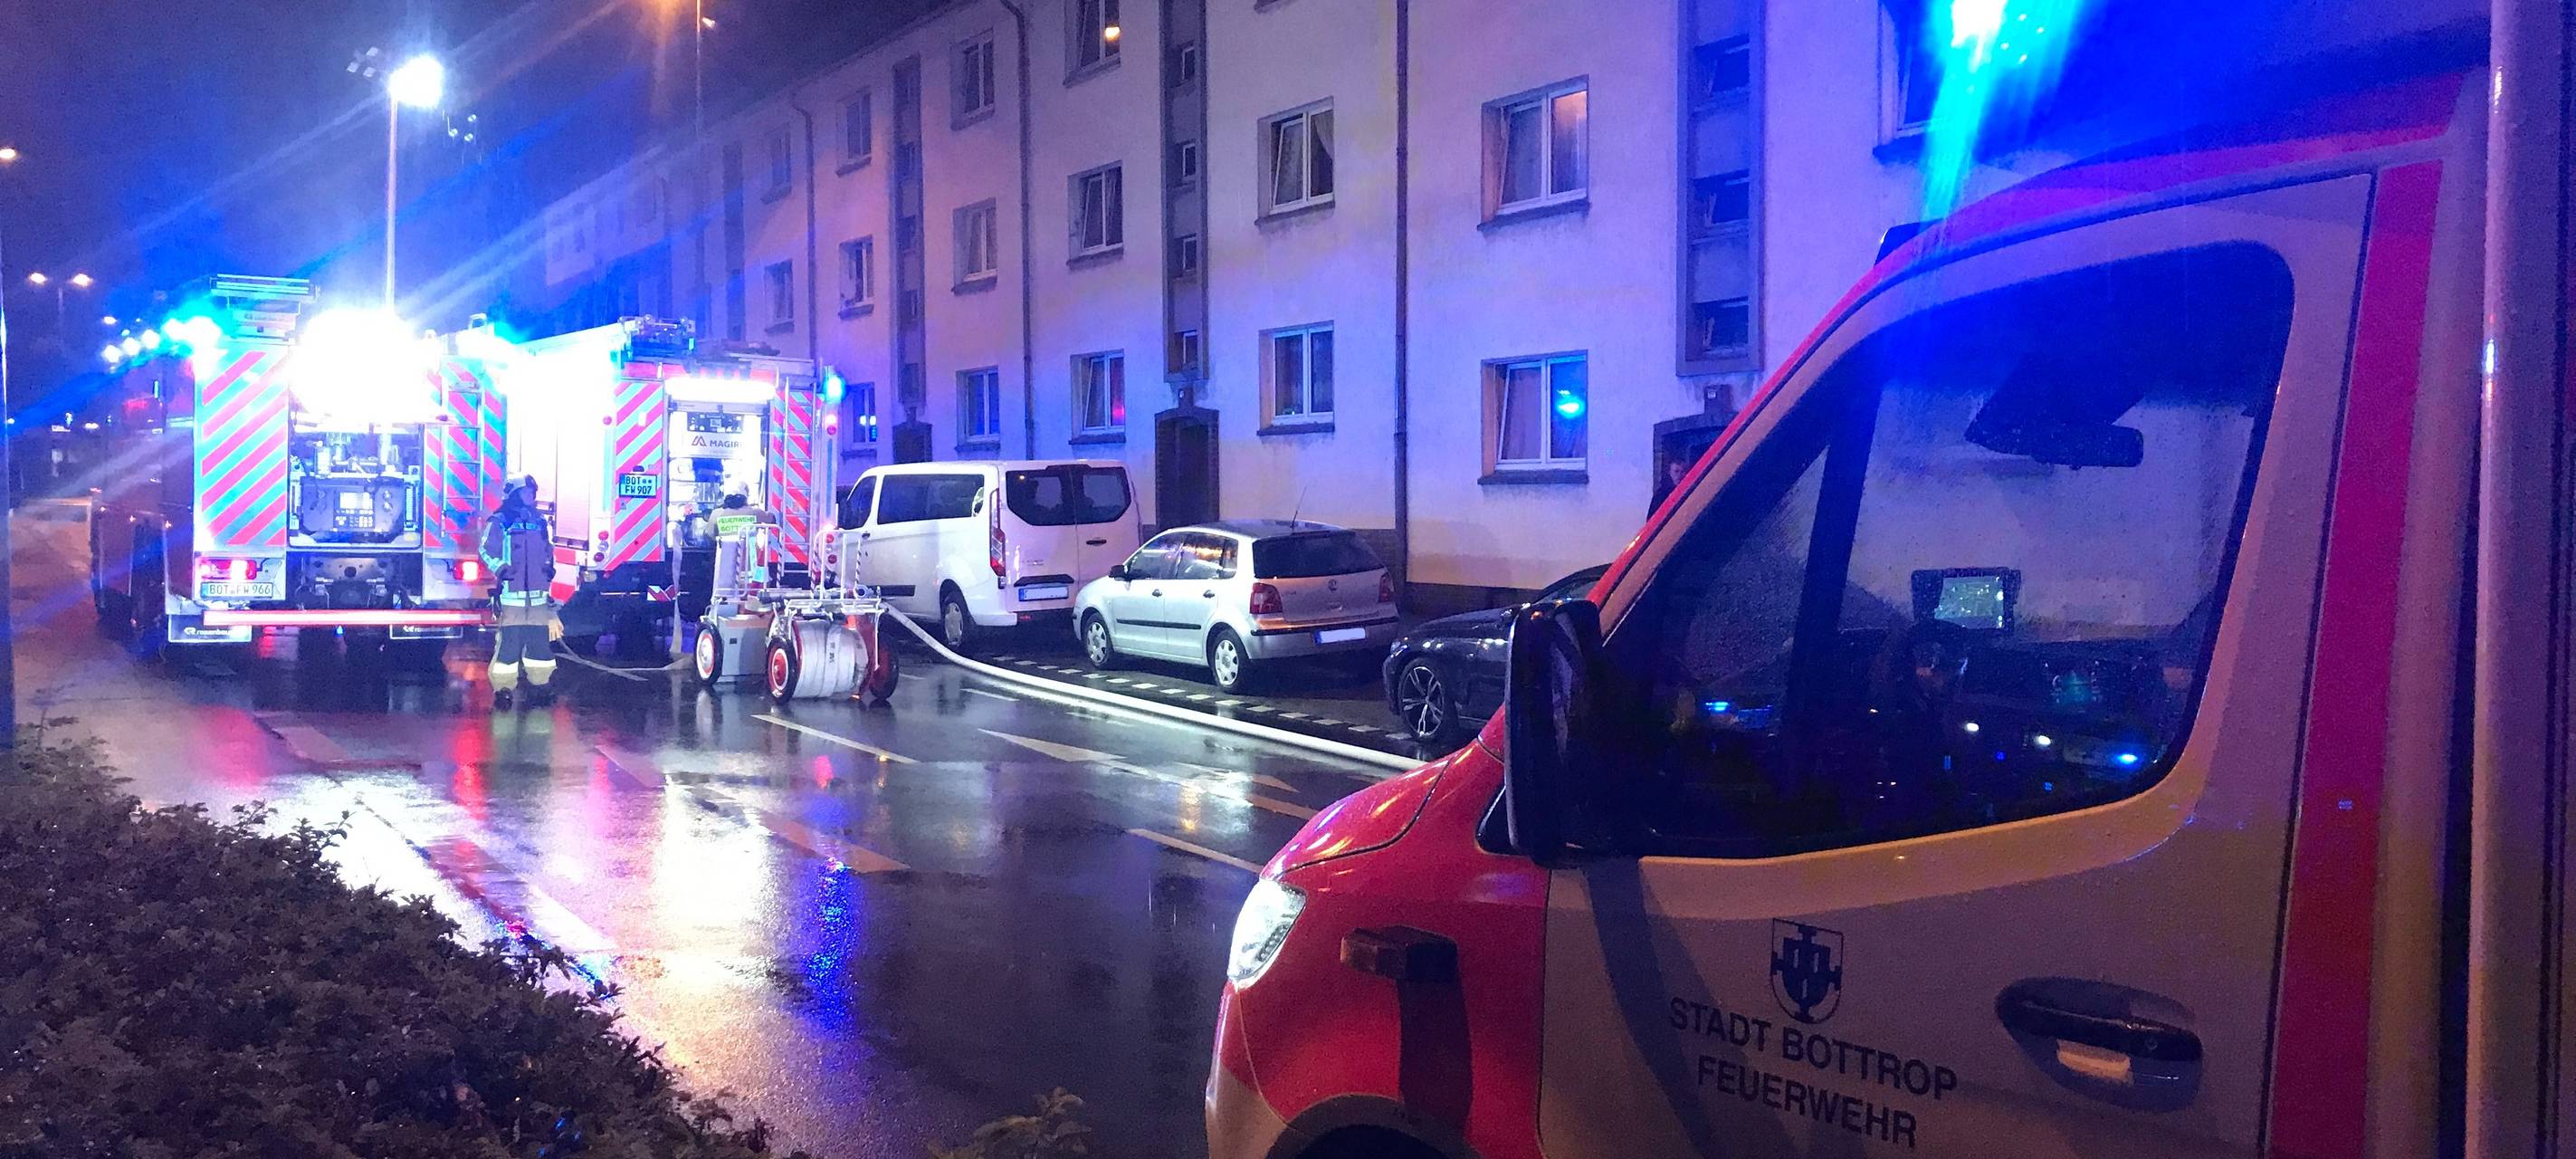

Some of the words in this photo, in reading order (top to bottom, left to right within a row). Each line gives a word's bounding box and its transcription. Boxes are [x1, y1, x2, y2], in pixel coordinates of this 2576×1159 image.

[710, 439, 742, 448] MAGIR
[625, 476, 641, 485] BOT
[625, 485, 636, 494] FW
[637, 485, 652, 494] 907
[209, 584, 229, 595] BOT
[236, 584, 249, 594] FW
[252, 584, 271, 595] 966
[1670, 997, 1771, 1051] STADT
[1781, 1027, 1958, 1100] BOTTROP
[1697, 1054, 1917, 1148] FEUERWEHR
